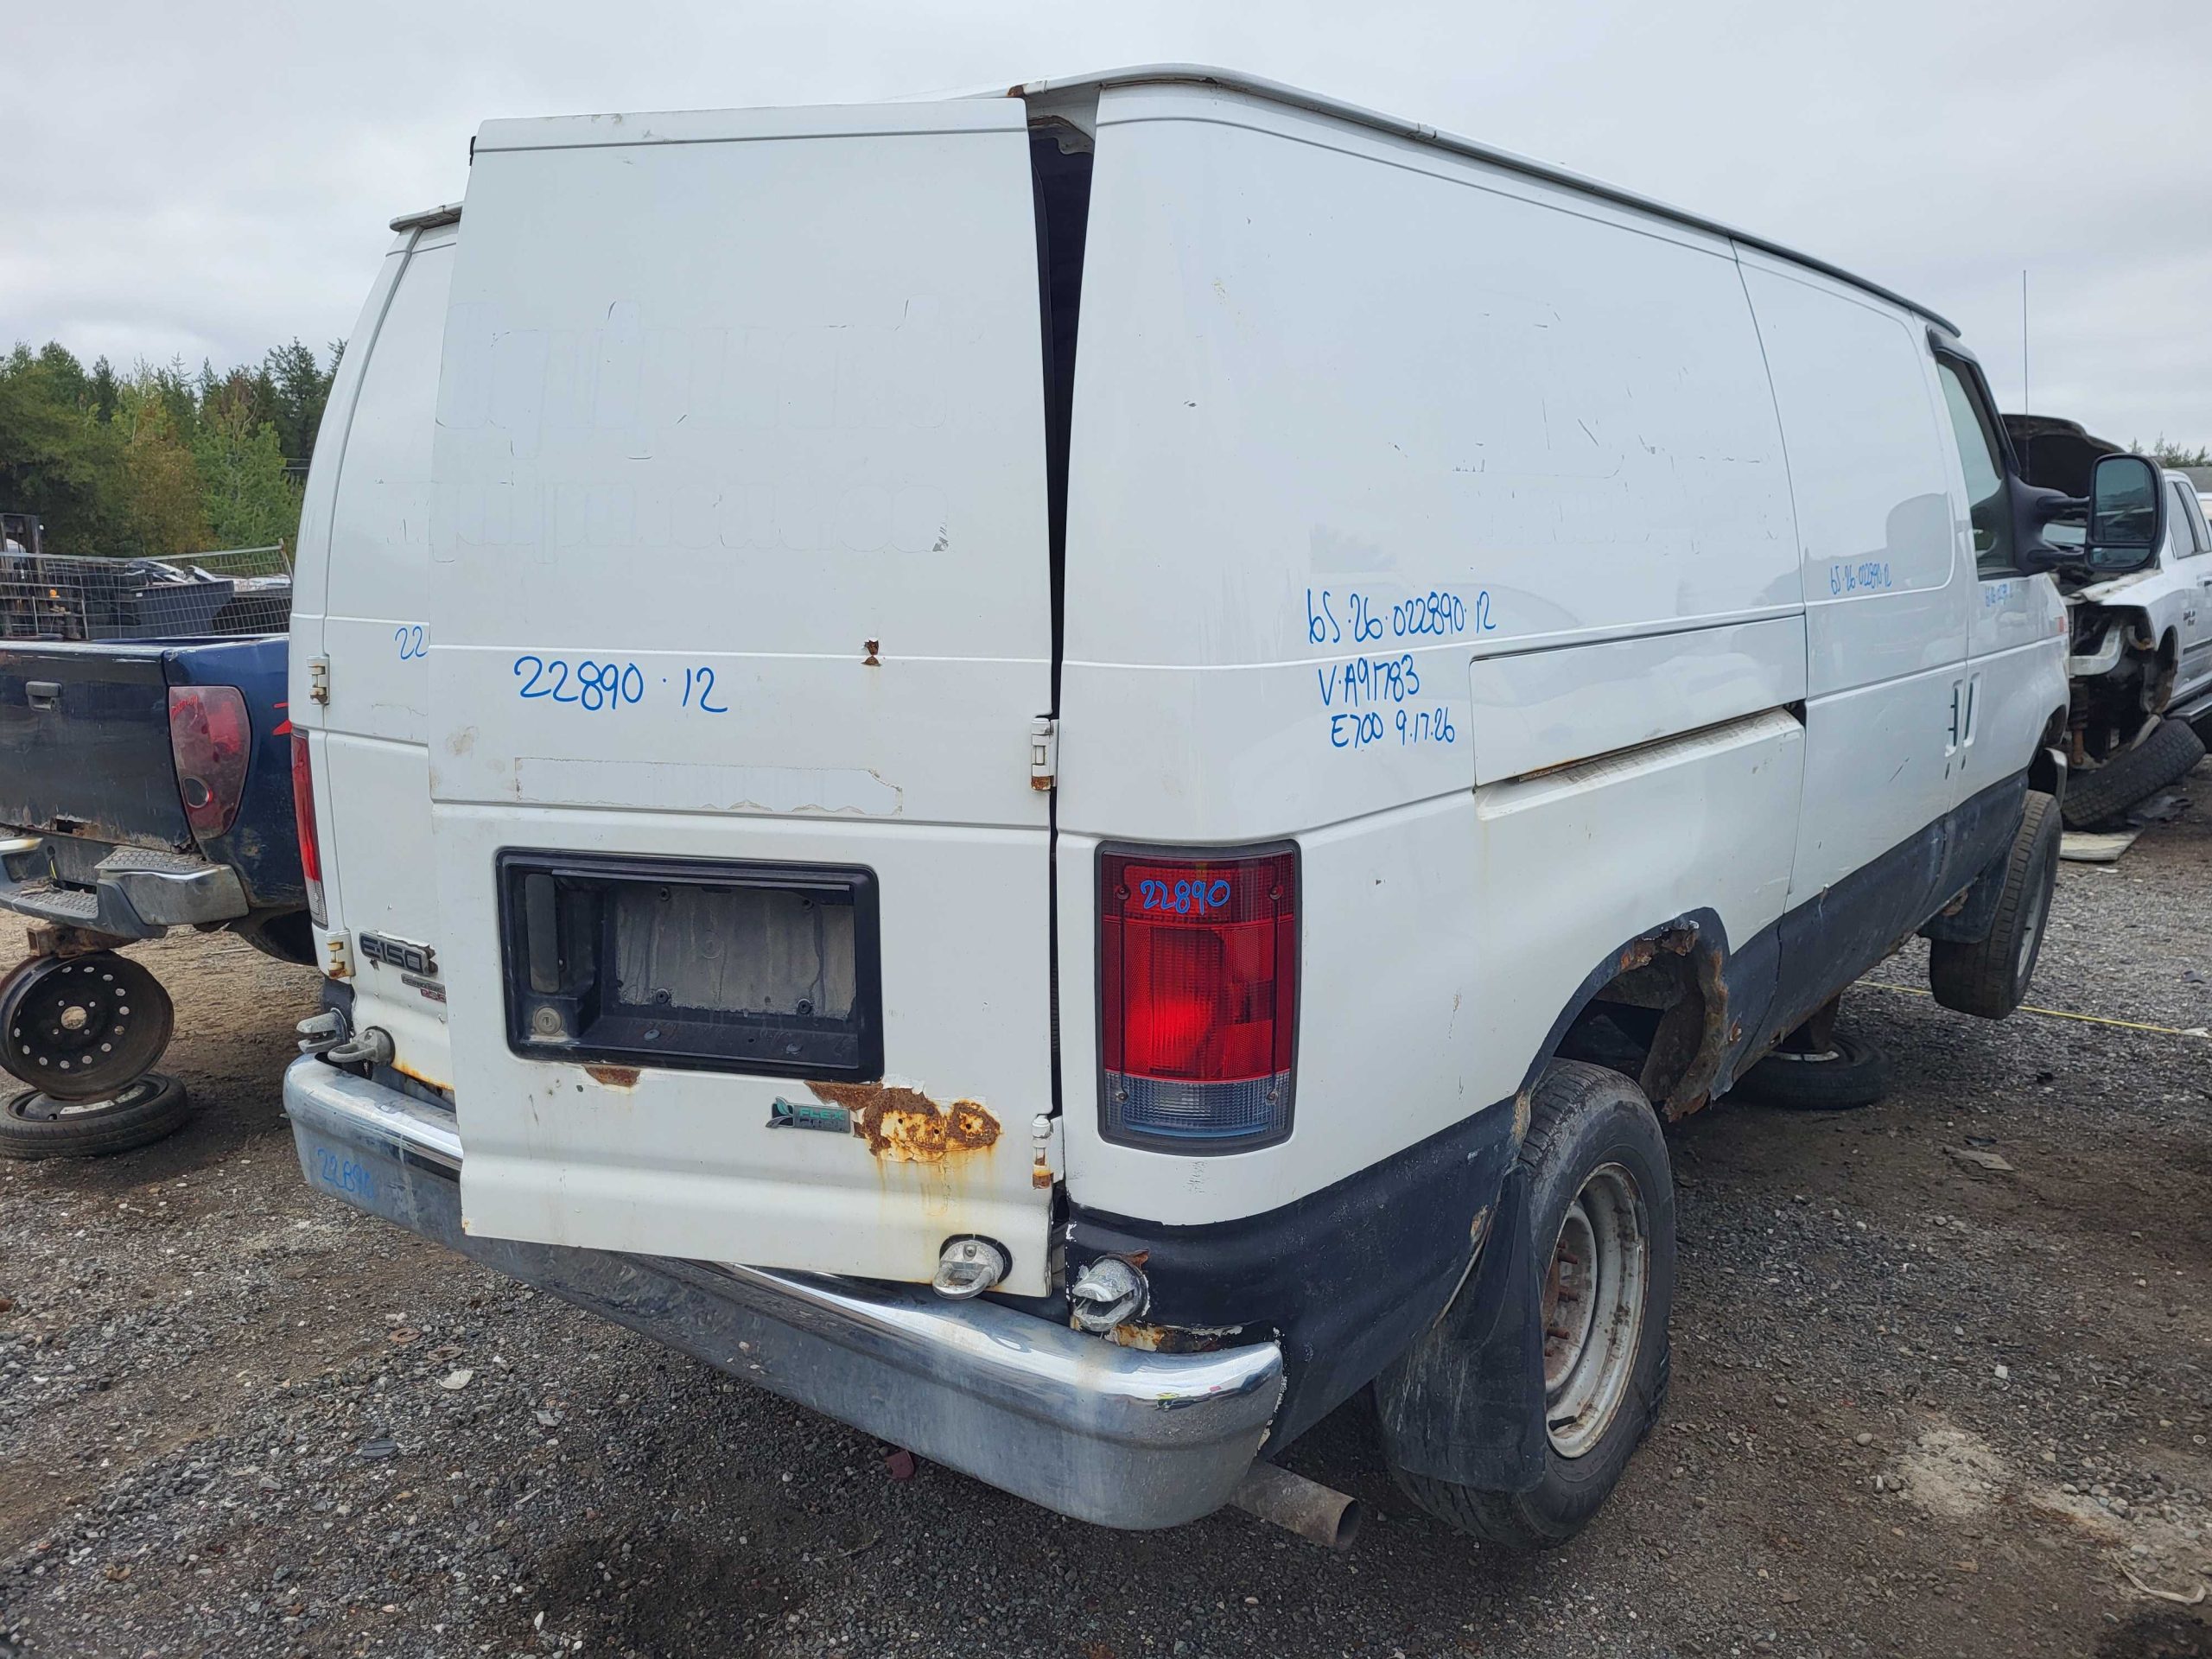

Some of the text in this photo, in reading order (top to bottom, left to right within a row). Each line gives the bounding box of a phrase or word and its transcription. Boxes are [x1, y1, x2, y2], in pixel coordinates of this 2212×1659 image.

[513, 655, 645, 712] 22890
[1140, 879, 1231, 916] 22890
[799, 1107, 845, 1121] FLEX
